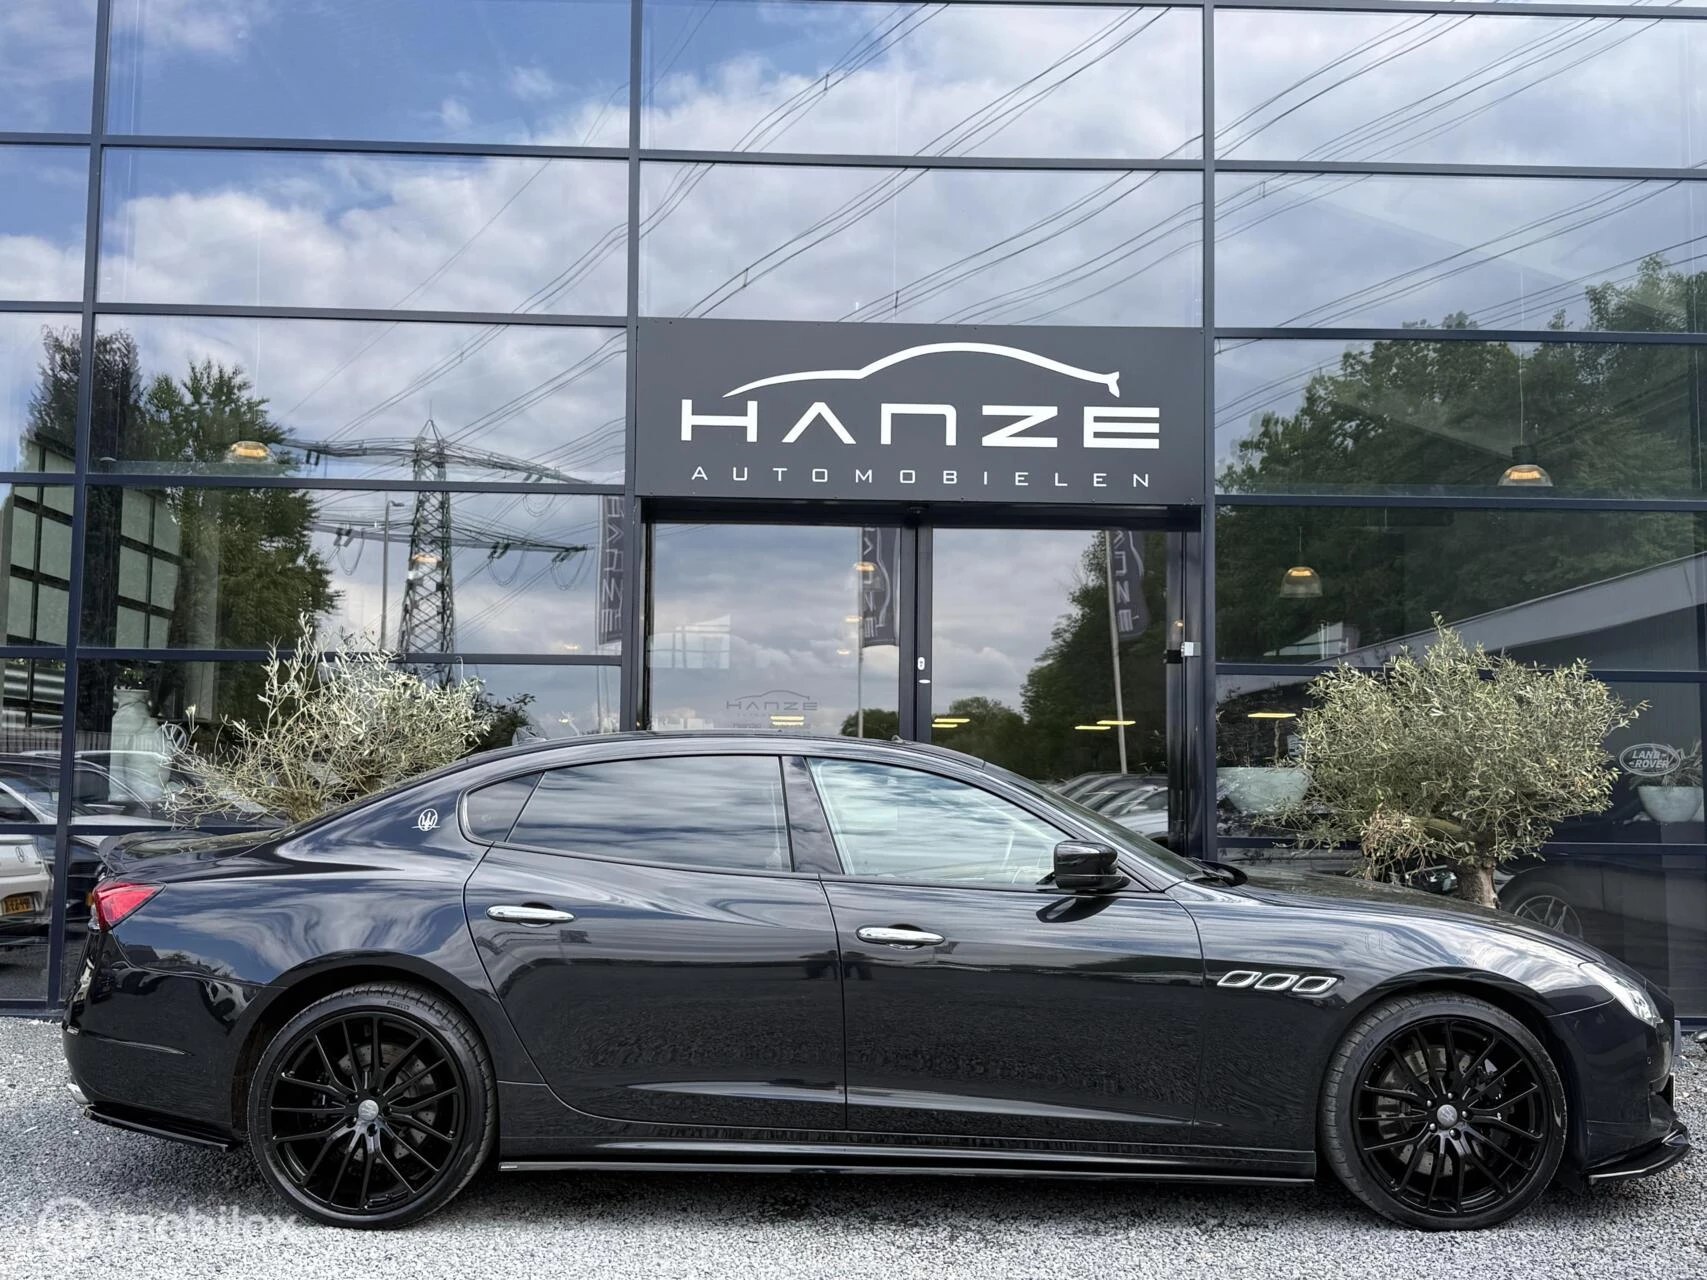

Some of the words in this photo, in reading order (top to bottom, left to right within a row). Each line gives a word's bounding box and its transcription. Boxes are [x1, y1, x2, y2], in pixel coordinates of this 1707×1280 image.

[681, 399, 1160, 449] HANZE
[691, 466, 1149, 488] AUTOMOBIELEN
[1113, 530, 1134, 633] ANZE
[726, 701, 818, 711] HANZE
